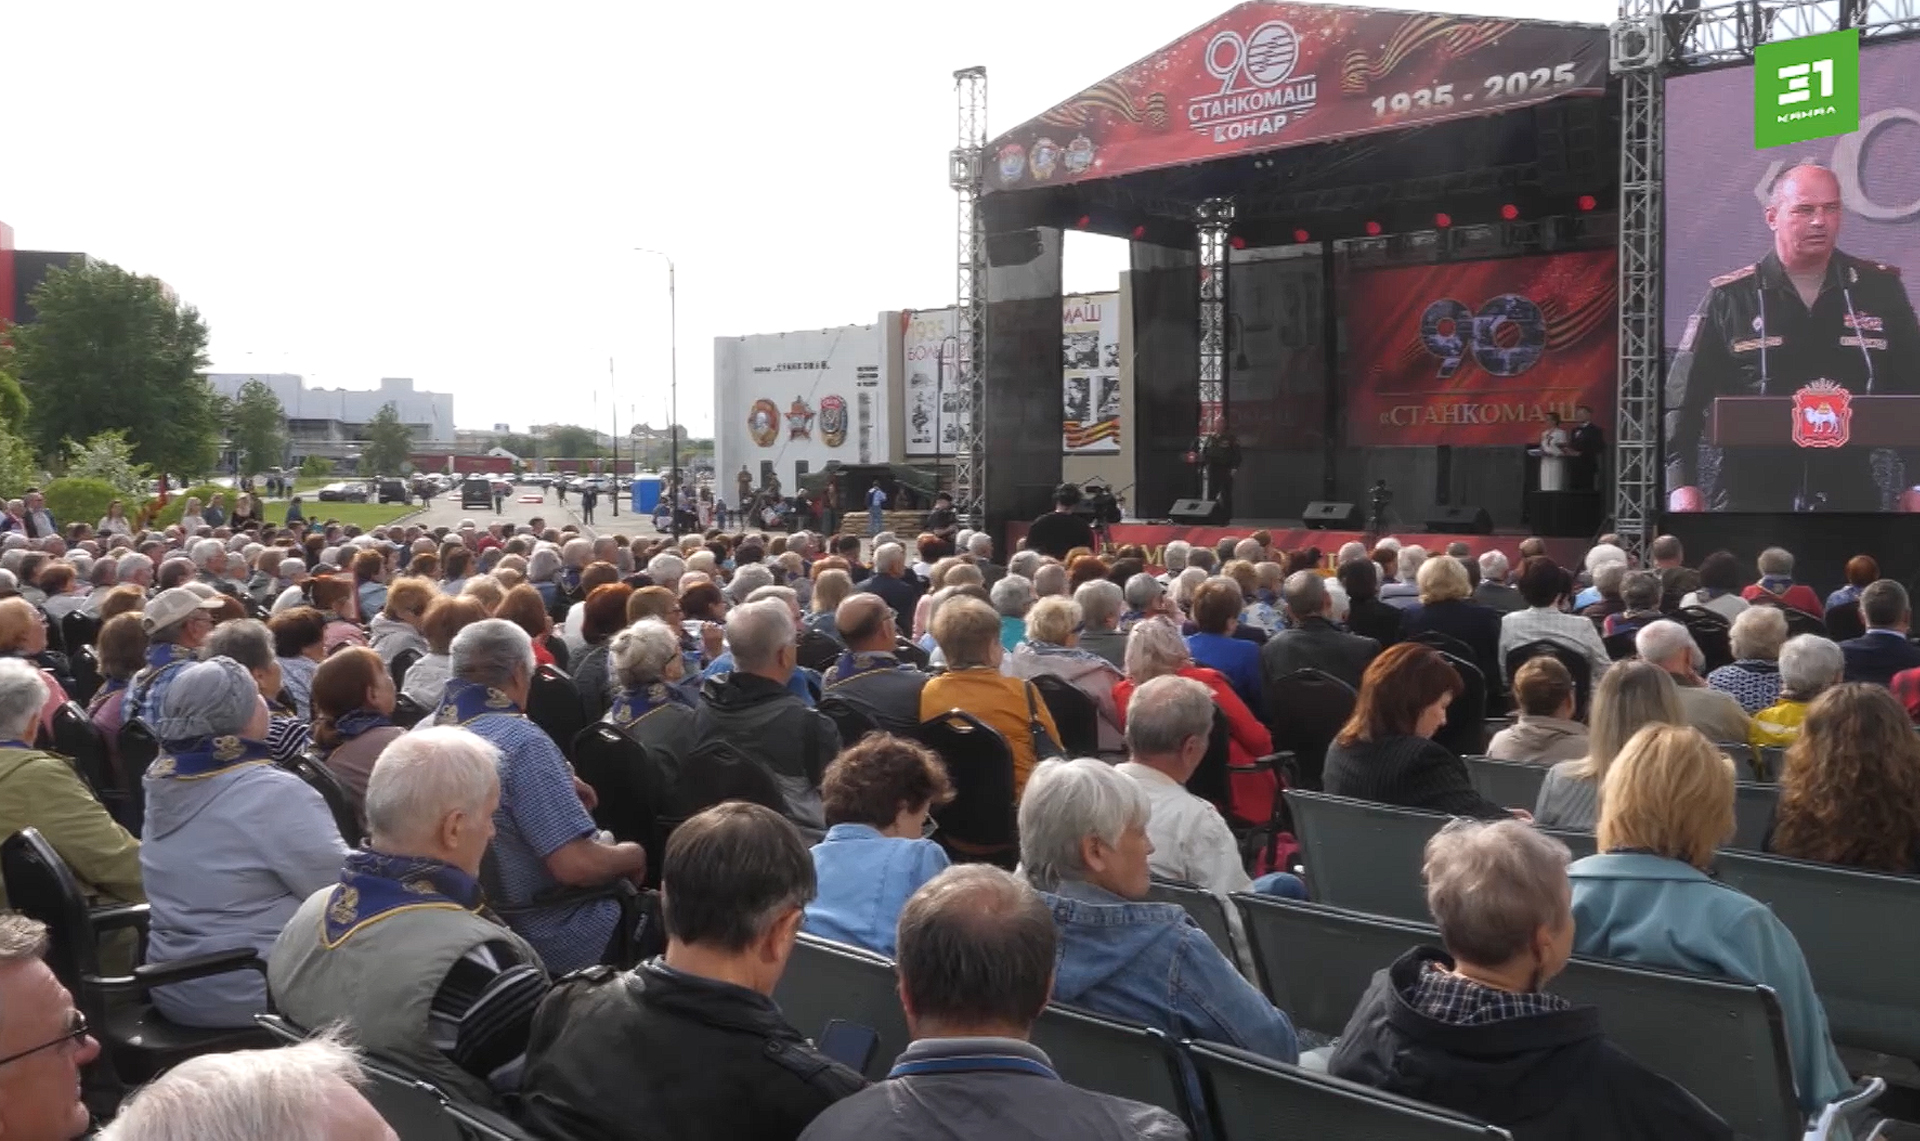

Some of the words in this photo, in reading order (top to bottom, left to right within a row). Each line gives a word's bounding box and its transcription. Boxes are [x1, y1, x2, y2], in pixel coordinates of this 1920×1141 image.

[1205, 20, 1299, 95] 90
[1188, 81, 1317, 121] СТАНКОМАШ
[1371, 84, 1454, 117] 1935
[1484, 62, 1576, 99] 2025
[1213, 115, 1288, 142] КОНАР
[1420, 293, 1547, 378] 90
